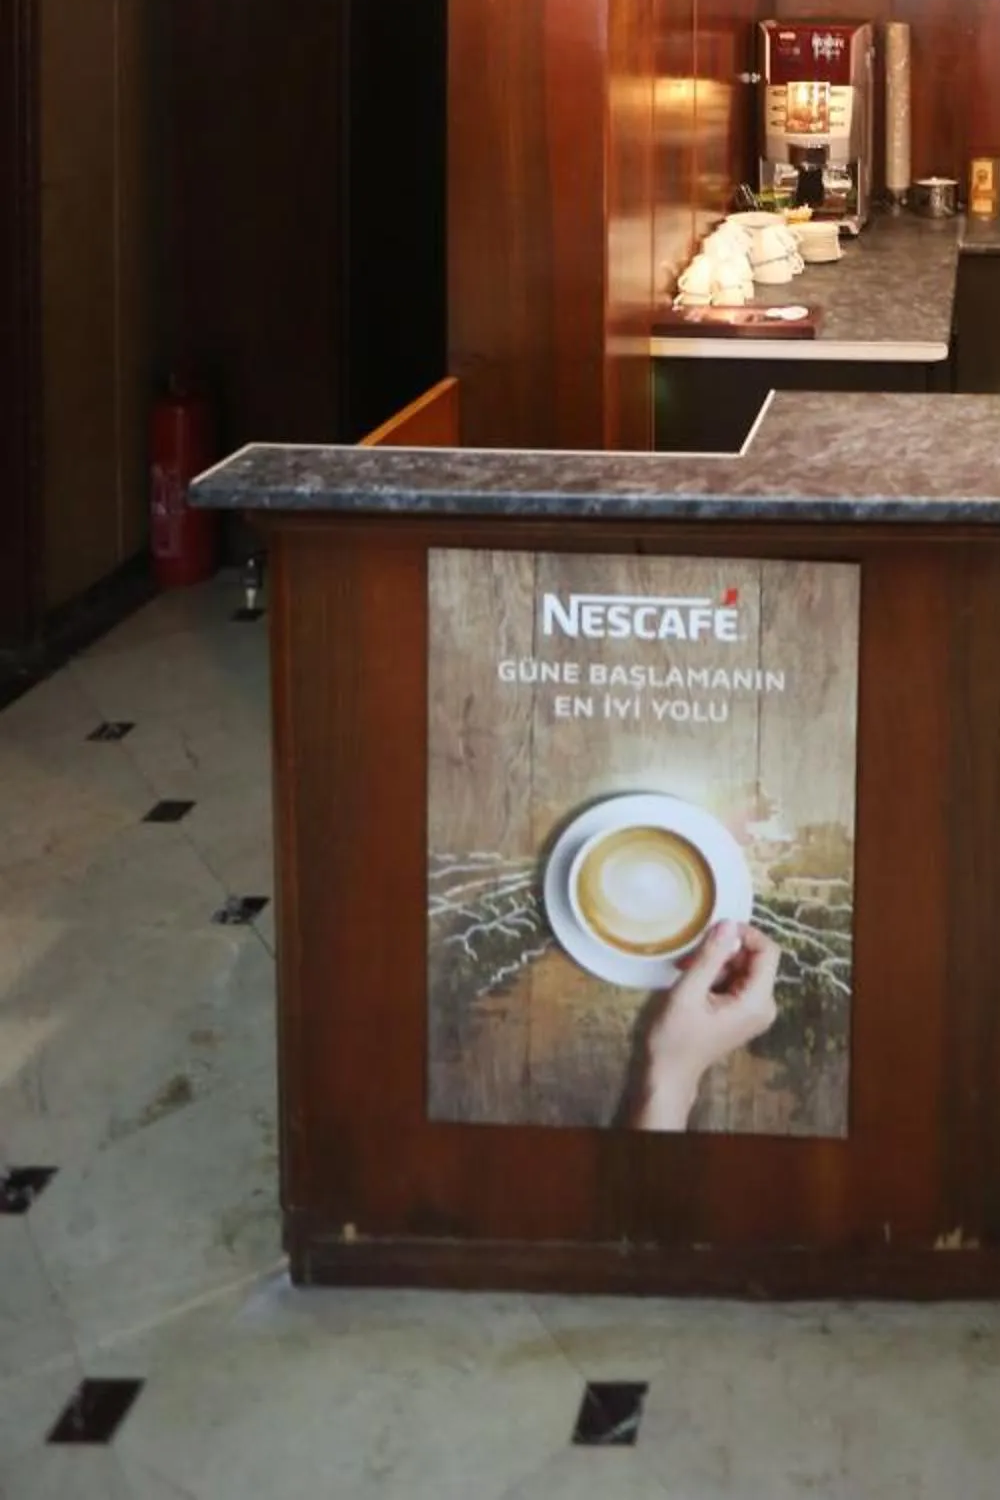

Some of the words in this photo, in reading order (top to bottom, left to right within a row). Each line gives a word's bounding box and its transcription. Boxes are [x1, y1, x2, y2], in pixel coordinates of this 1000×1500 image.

[497, 657, 580, 684] GÜNE
[589, 662, 786, 692] BAŞLAMANIN
[554, 696, 594, 718] EN
[604, 694, 641, 719] İYİ
[651, 701, 729, 723] YOLU
